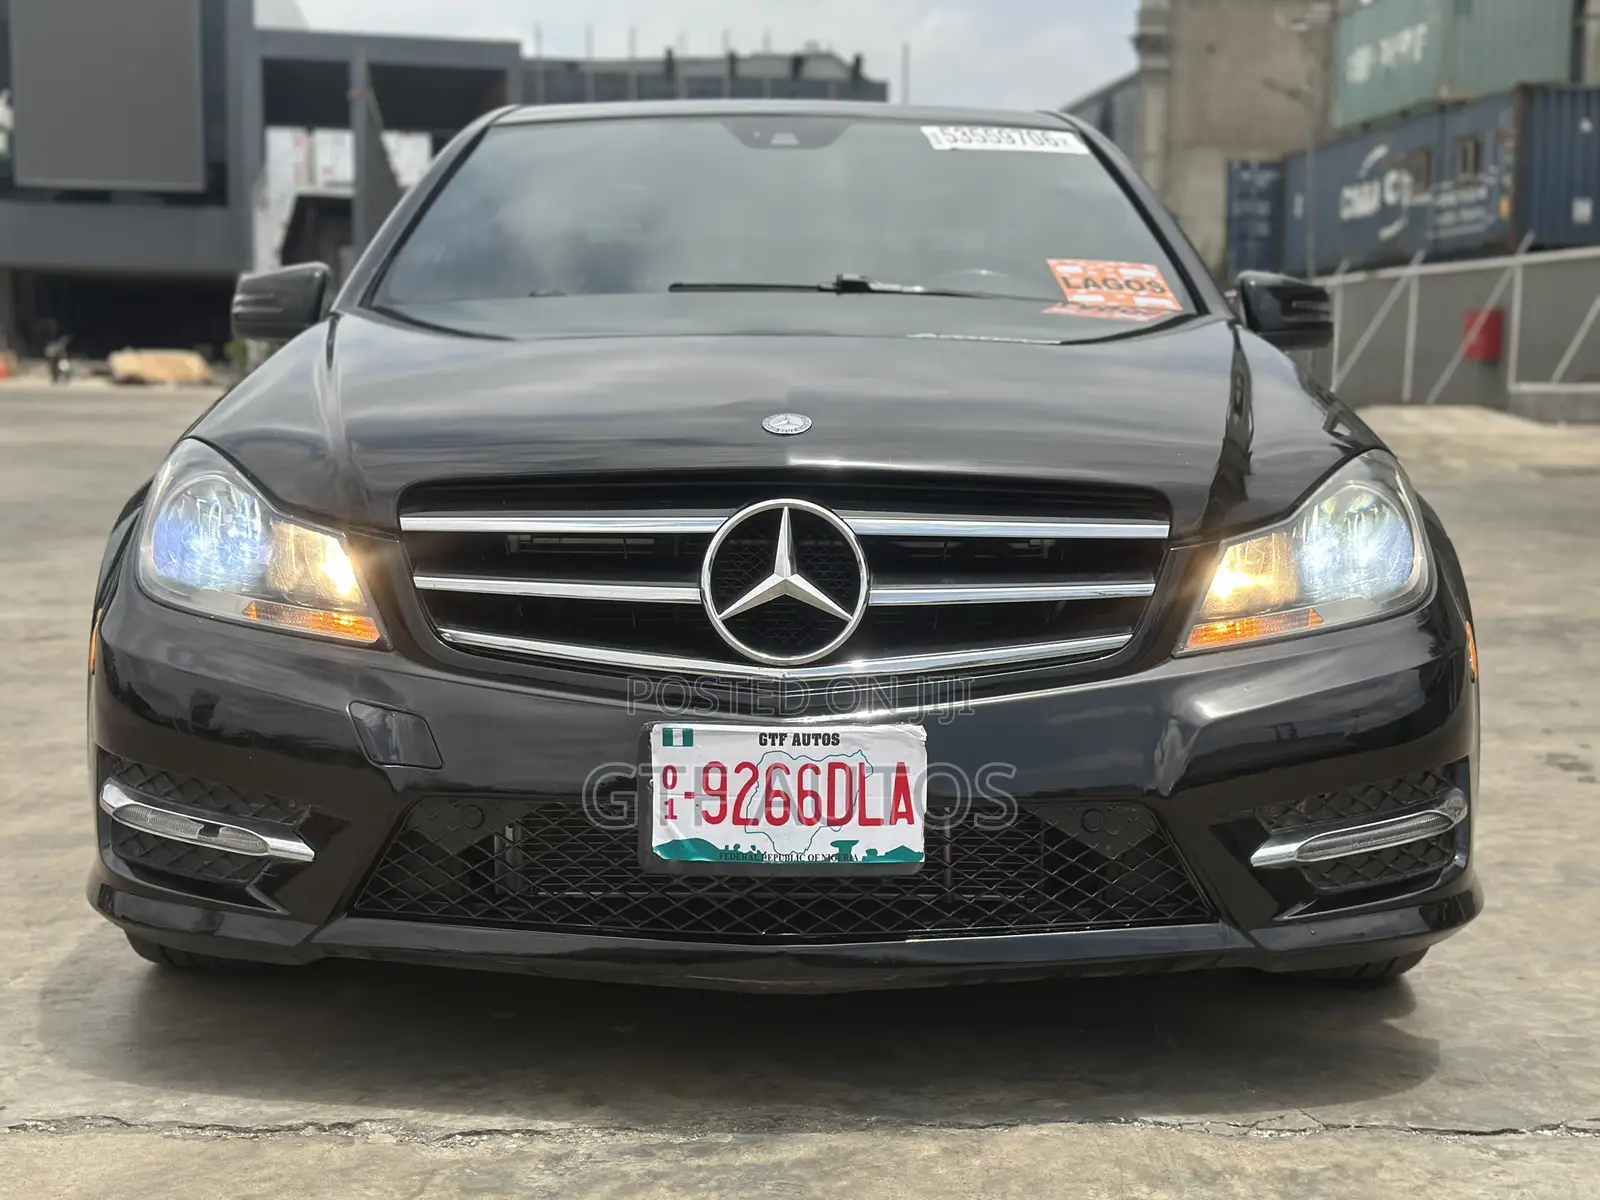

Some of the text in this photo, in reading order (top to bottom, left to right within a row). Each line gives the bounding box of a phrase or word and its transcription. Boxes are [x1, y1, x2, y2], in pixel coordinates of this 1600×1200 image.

[1061, 276, 1166, 294] LAGOS
[758, 732, 841, 747] GTF AUTOS
[719, 852, 761, 862] FEDERAL
[808, 853, 821, 862] OF
